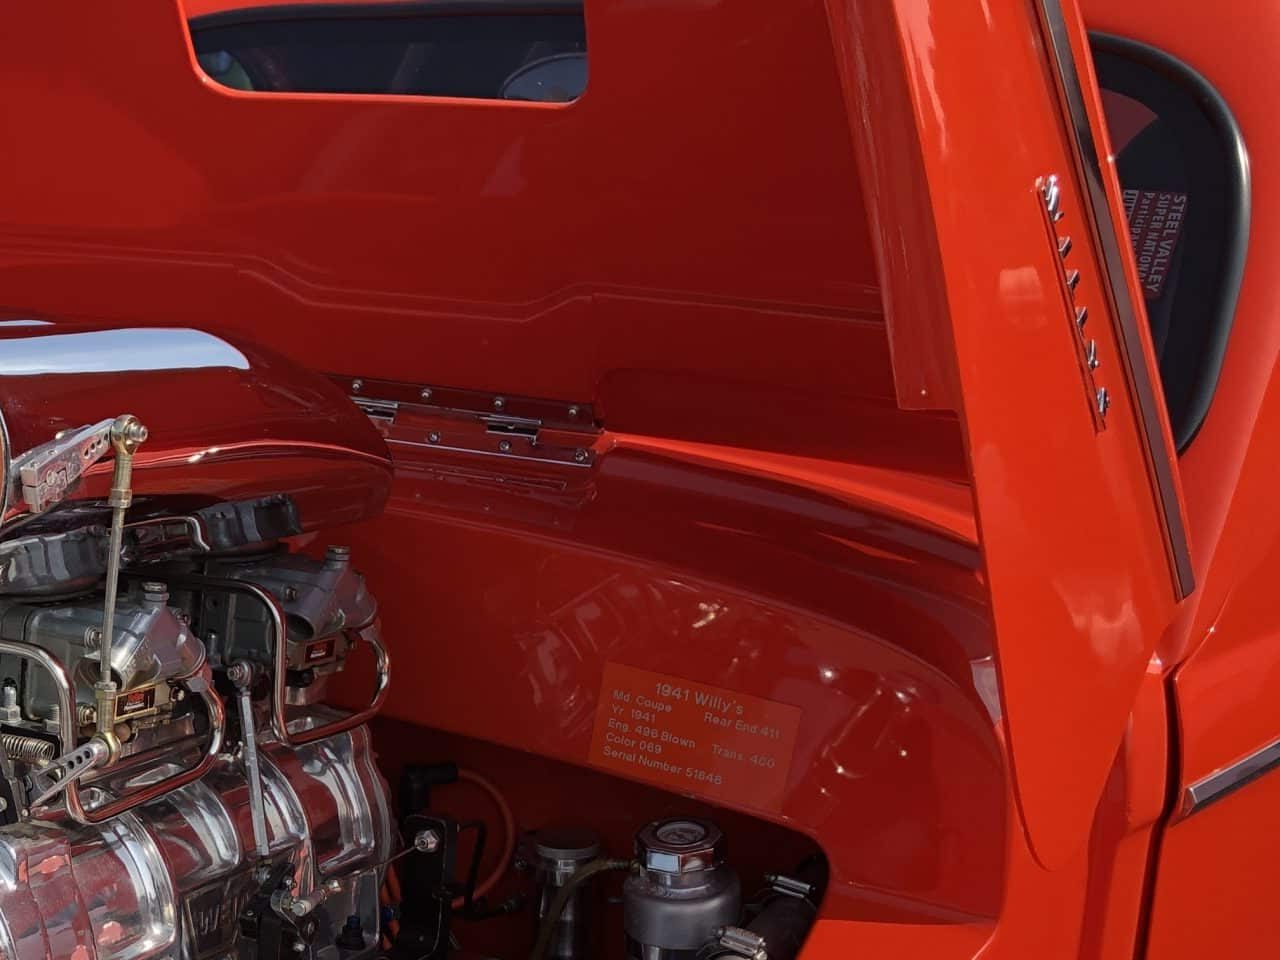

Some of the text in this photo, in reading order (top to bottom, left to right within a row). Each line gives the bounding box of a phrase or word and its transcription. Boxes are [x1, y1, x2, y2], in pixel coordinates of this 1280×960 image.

[1138, 193, 1171, 283] SUPER NATIONA
[1146, 195, 1187, 292] STEEL VALLEY
[636, 695, 673, 713] Coupe
[656, 683, 744, 715] 1941 Willy's
[631, 709, 656, 723] 1941
[704, 712, 732, 729] Rear
[606, 732, 637, 747] Color
[661, 731, 696, 749] Blown
[603, 745, 636, 762] Serial
[638, 755, 683, 775] Number
